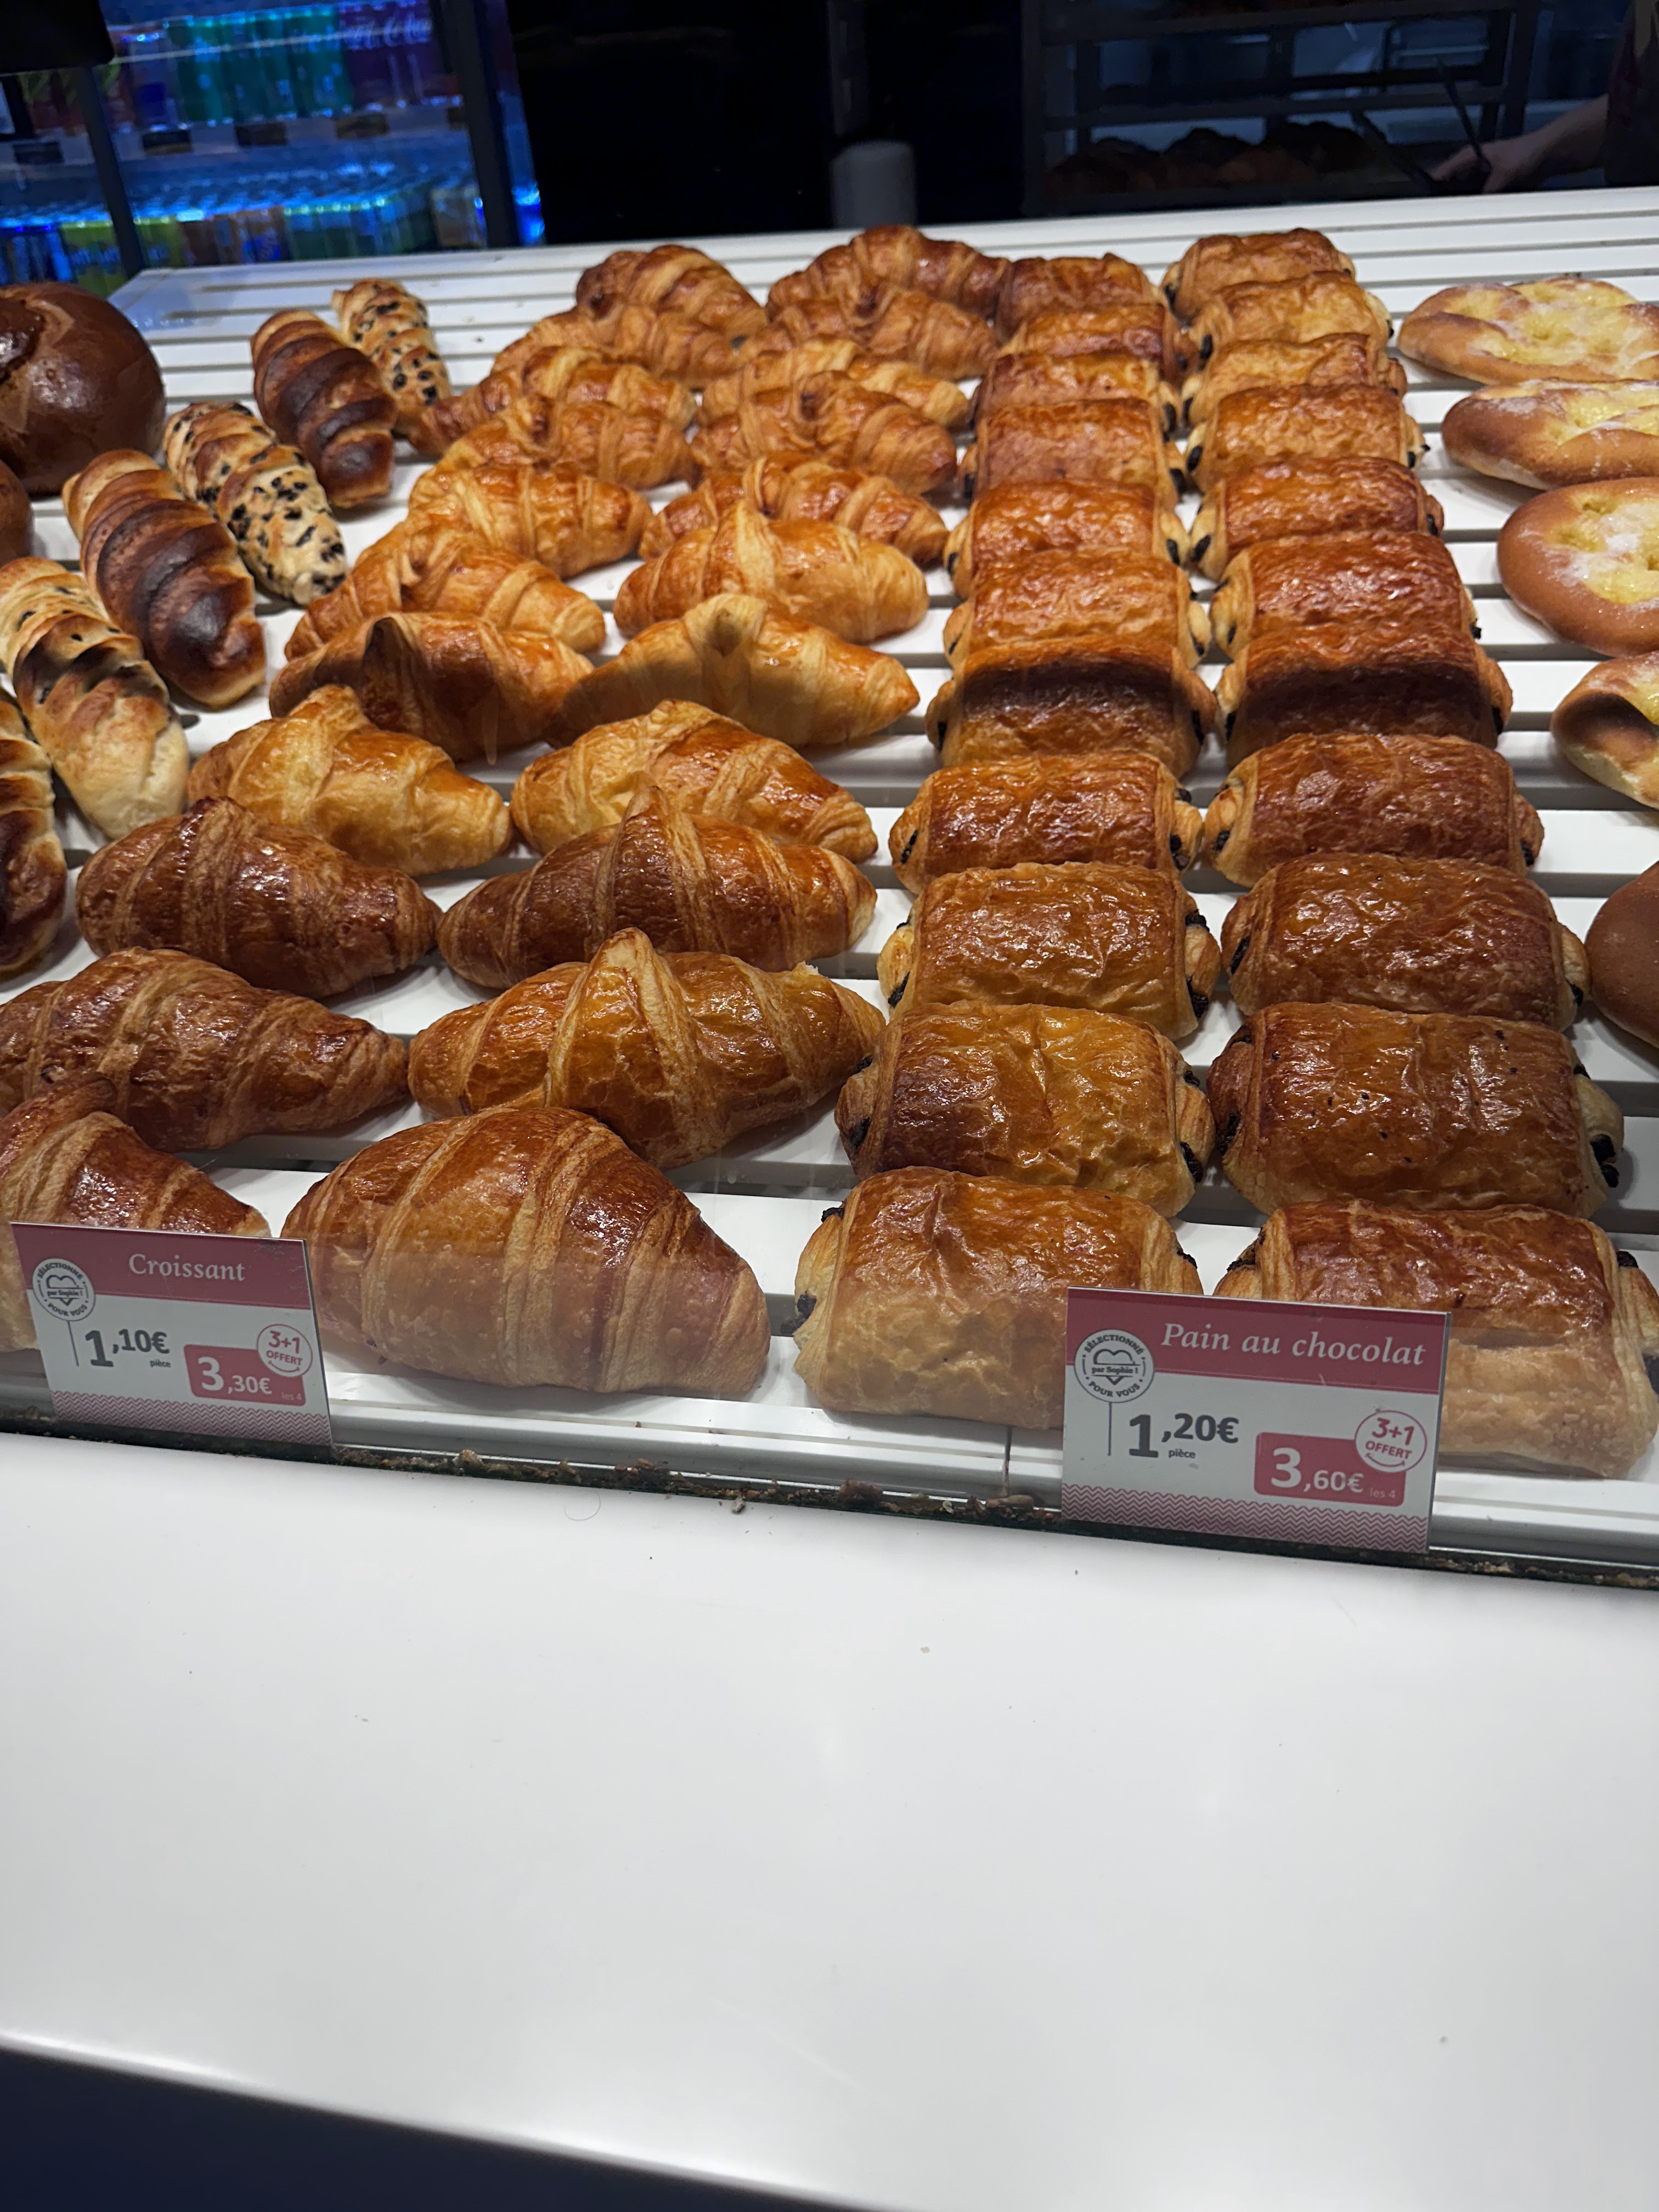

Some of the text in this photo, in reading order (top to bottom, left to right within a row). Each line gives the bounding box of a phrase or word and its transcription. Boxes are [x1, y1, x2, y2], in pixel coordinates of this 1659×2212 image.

[128, 1254, 245, 1282] Croissant
[48, 1303, 87, 1316] POUR VOUS
[85, 1328, 170, 1367] 1,10€
[269, 1330, 301, 1354] 3+1
[1160, 1323, 1426, 1365] Pain au chocolat
[150, 1359, 171, 1368] pièce
[266, 1350, 303, 1365] OFFERT
[198, 1356, 273, 1394] 3,30€
[281, 1391, 295, 1400] les
[1088, 1381, 1140, 1397] POUR VOUS
[1128, 1413, 1239, 1458] 1,20€
[1372, 1417, 1415, 1446] 3+1
[1168, 1448, 1196, 1458] pièce
[1365, 1440, 1413, 1459] OFFERT
[1271, 1447, 1364, 1493] 3,60€
[1369, 1487, 1396, 1498] les 4
